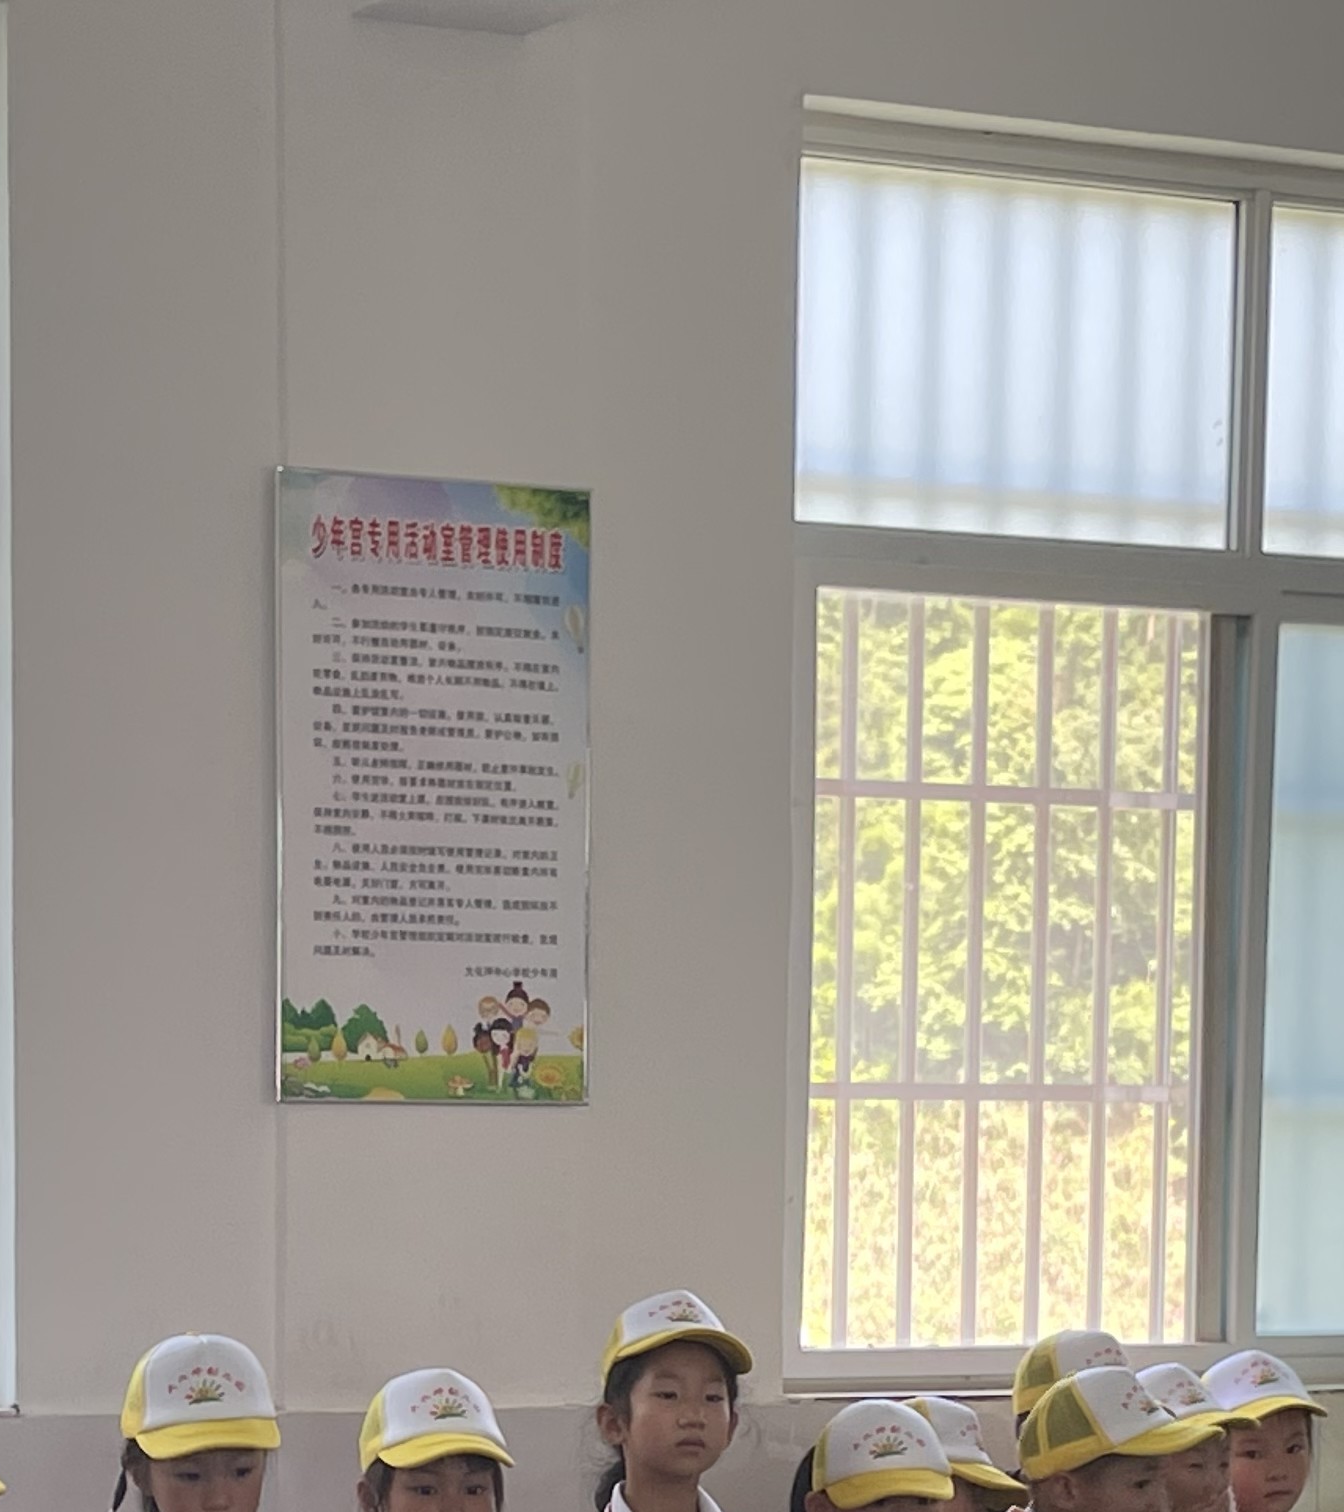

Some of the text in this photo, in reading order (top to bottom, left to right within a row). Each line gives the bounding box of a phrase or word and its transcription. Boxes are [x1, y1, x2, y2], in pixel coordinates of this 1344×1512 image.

[311, 514, 564, 570] 少年宫专用活动室管理使用制度
